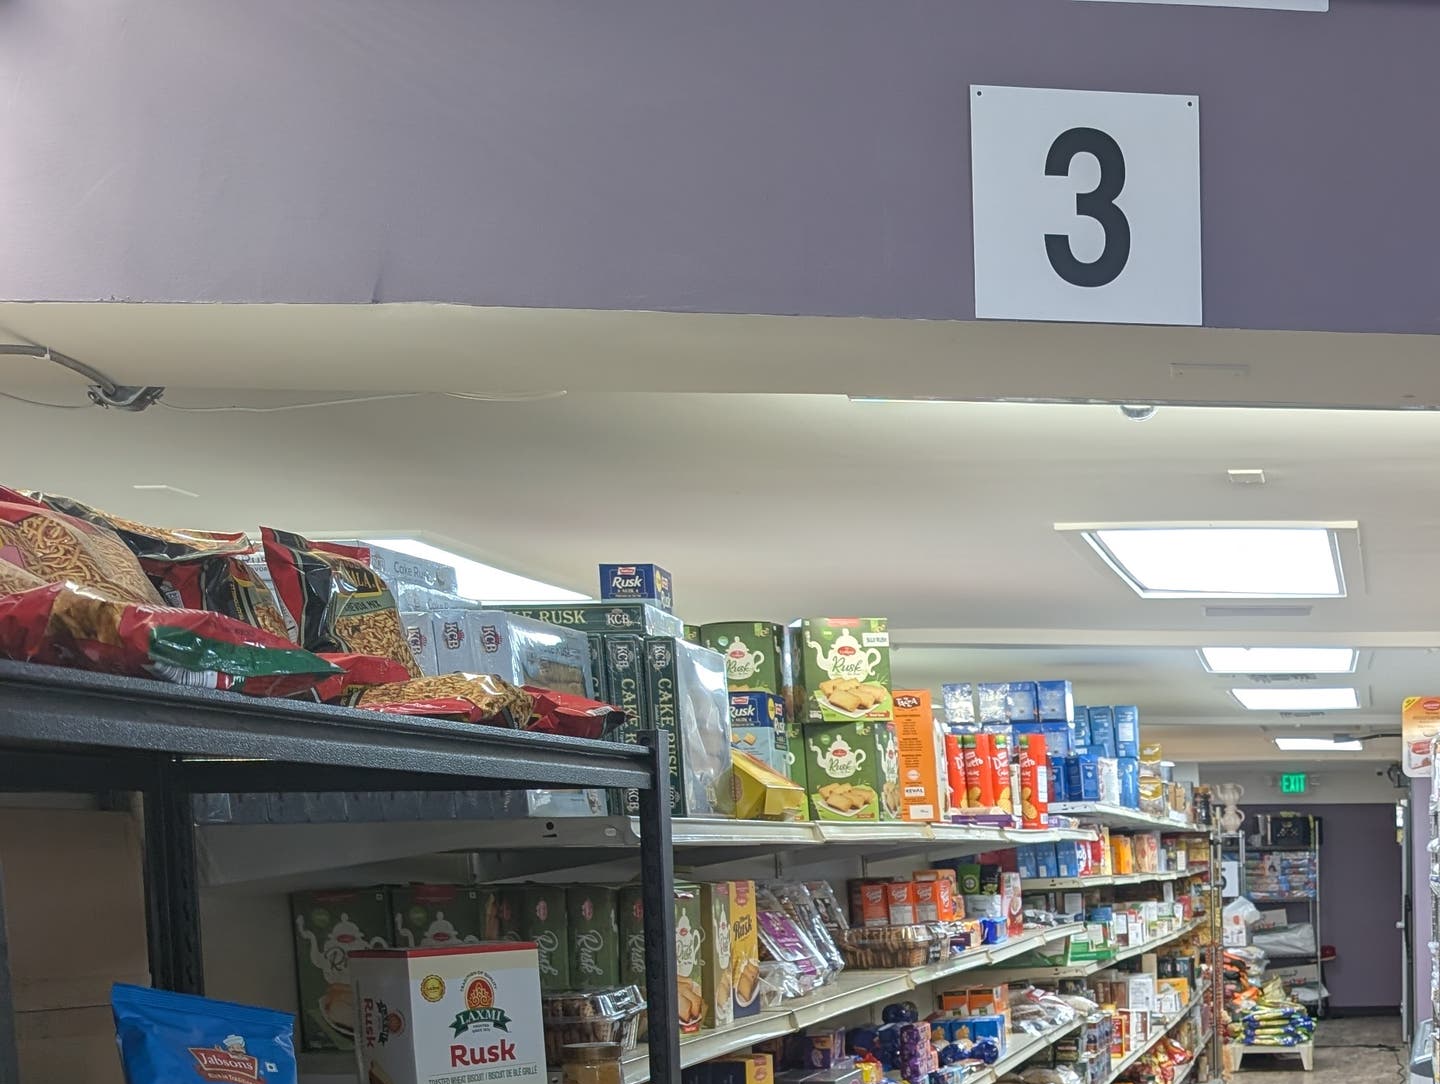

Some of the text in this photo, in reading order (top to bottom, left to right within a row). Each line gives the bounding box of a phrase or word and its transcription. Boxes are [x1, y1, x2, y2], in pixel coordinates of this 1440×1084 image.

[1044, 127, 1131, 288] 3
[612, 576, 643, 589] Rusk
[540, 609, 586, 625] RUSK
[607, 612, 630, 626] KCB
[407, 625, 423, 655] KCB
[444, 622, 461, 650] KCB
[481, 624, 499, 653] KCB
[616, 645, 630, 670] KCB
[653, 644, 667, 669] KCB
[832, 655, 864, 674] Rusk
[656, 678, 674, 727] CAKE
[730, 705, 756, 717] Rusk
[829, 758, 853, 773] Rusk
[1282, 773, 1307, 793] EXIT
[733, 918, 753, 941] Rusk
[576, 928, 604, 977] Rusk
[363, 997, 376, 1049] Rusk
[460, 1009, 502, 1025] LAXMI
[200, 1052, 254, 1071] Jabsons
[450, 1038, 517, 1069] Rusk
[451, 1075, 467, 1084] WHEAT
[467, 1073, 485, 1083] BISCUIT
[488, 1070, 505, 1080] BISCUIT
